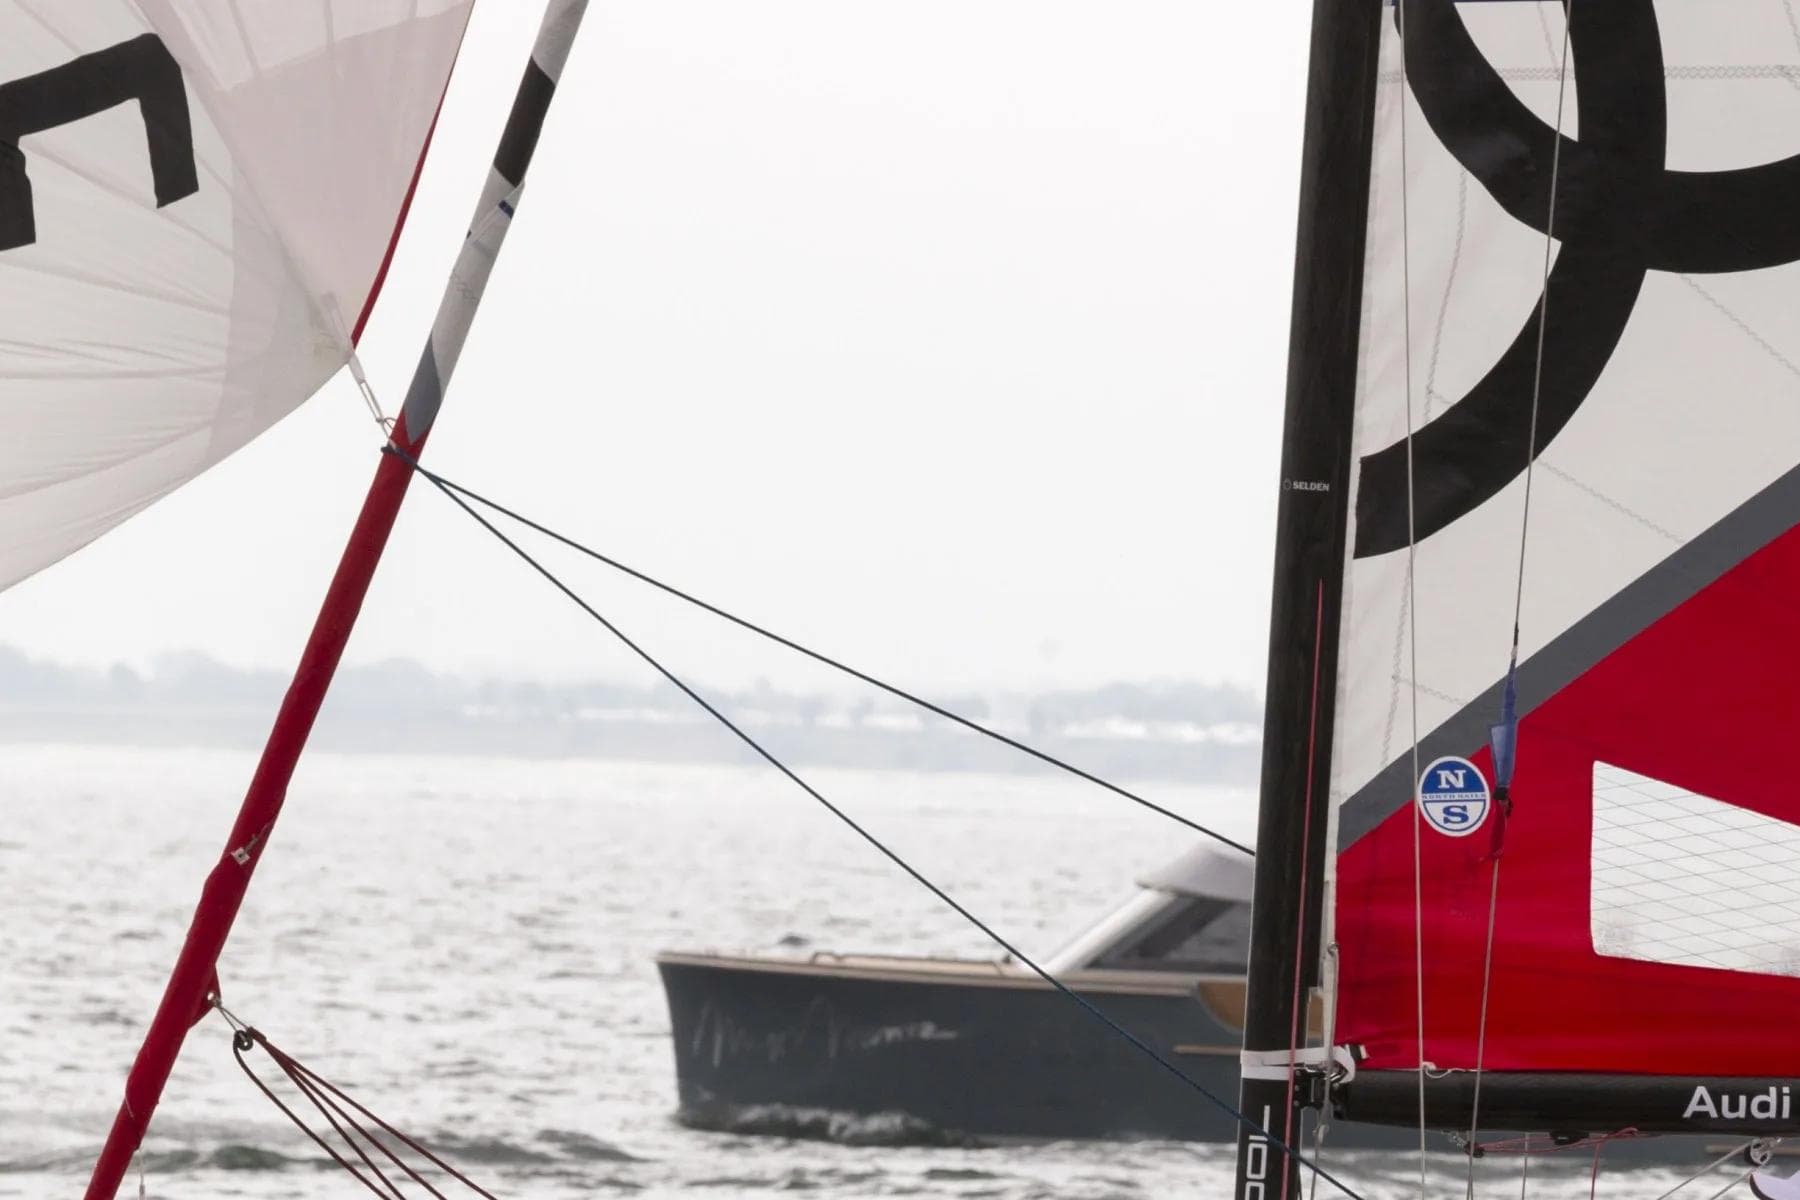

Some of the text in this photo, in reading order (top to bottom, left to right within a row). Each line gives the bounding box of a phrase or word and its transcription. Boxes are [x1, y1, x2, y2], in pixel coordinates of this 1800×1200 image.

[1436, 769, 1467, 789] N
[1442, 805, 1469, 824] S
[1682, 1085, 1790, 1120] Audi
